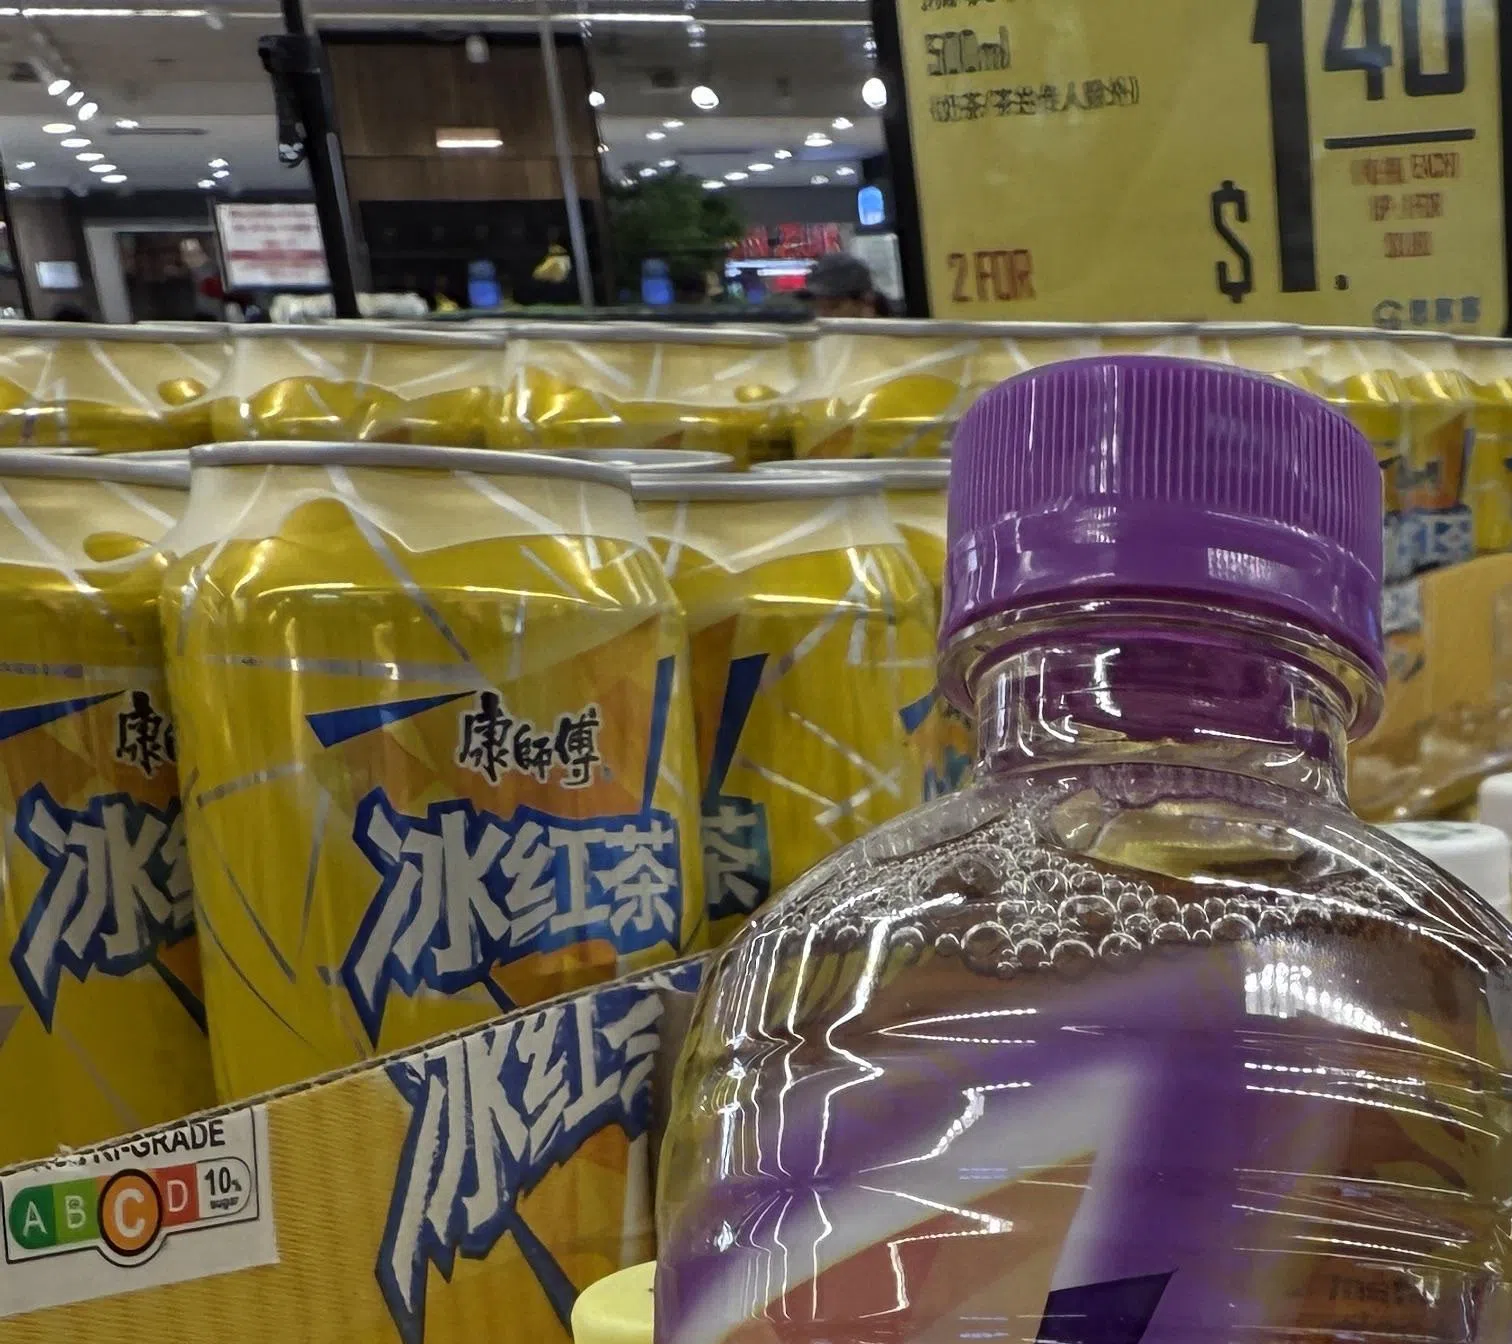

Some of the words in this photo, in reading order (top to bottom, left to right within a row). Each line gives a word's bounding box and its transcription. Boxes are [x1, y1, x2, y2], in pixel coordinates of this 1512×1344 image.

[948, 252, 973, 302] 2
[975, 248, 1037, 301] FOR
[352, 803, 680, 1013] 冰红茶
[22, 1201, 48, 1237] A
[65, 1195, 86, 1229] B
[113, 1188, 146, 1238] C
[166, 1179, 189, 1212] D
